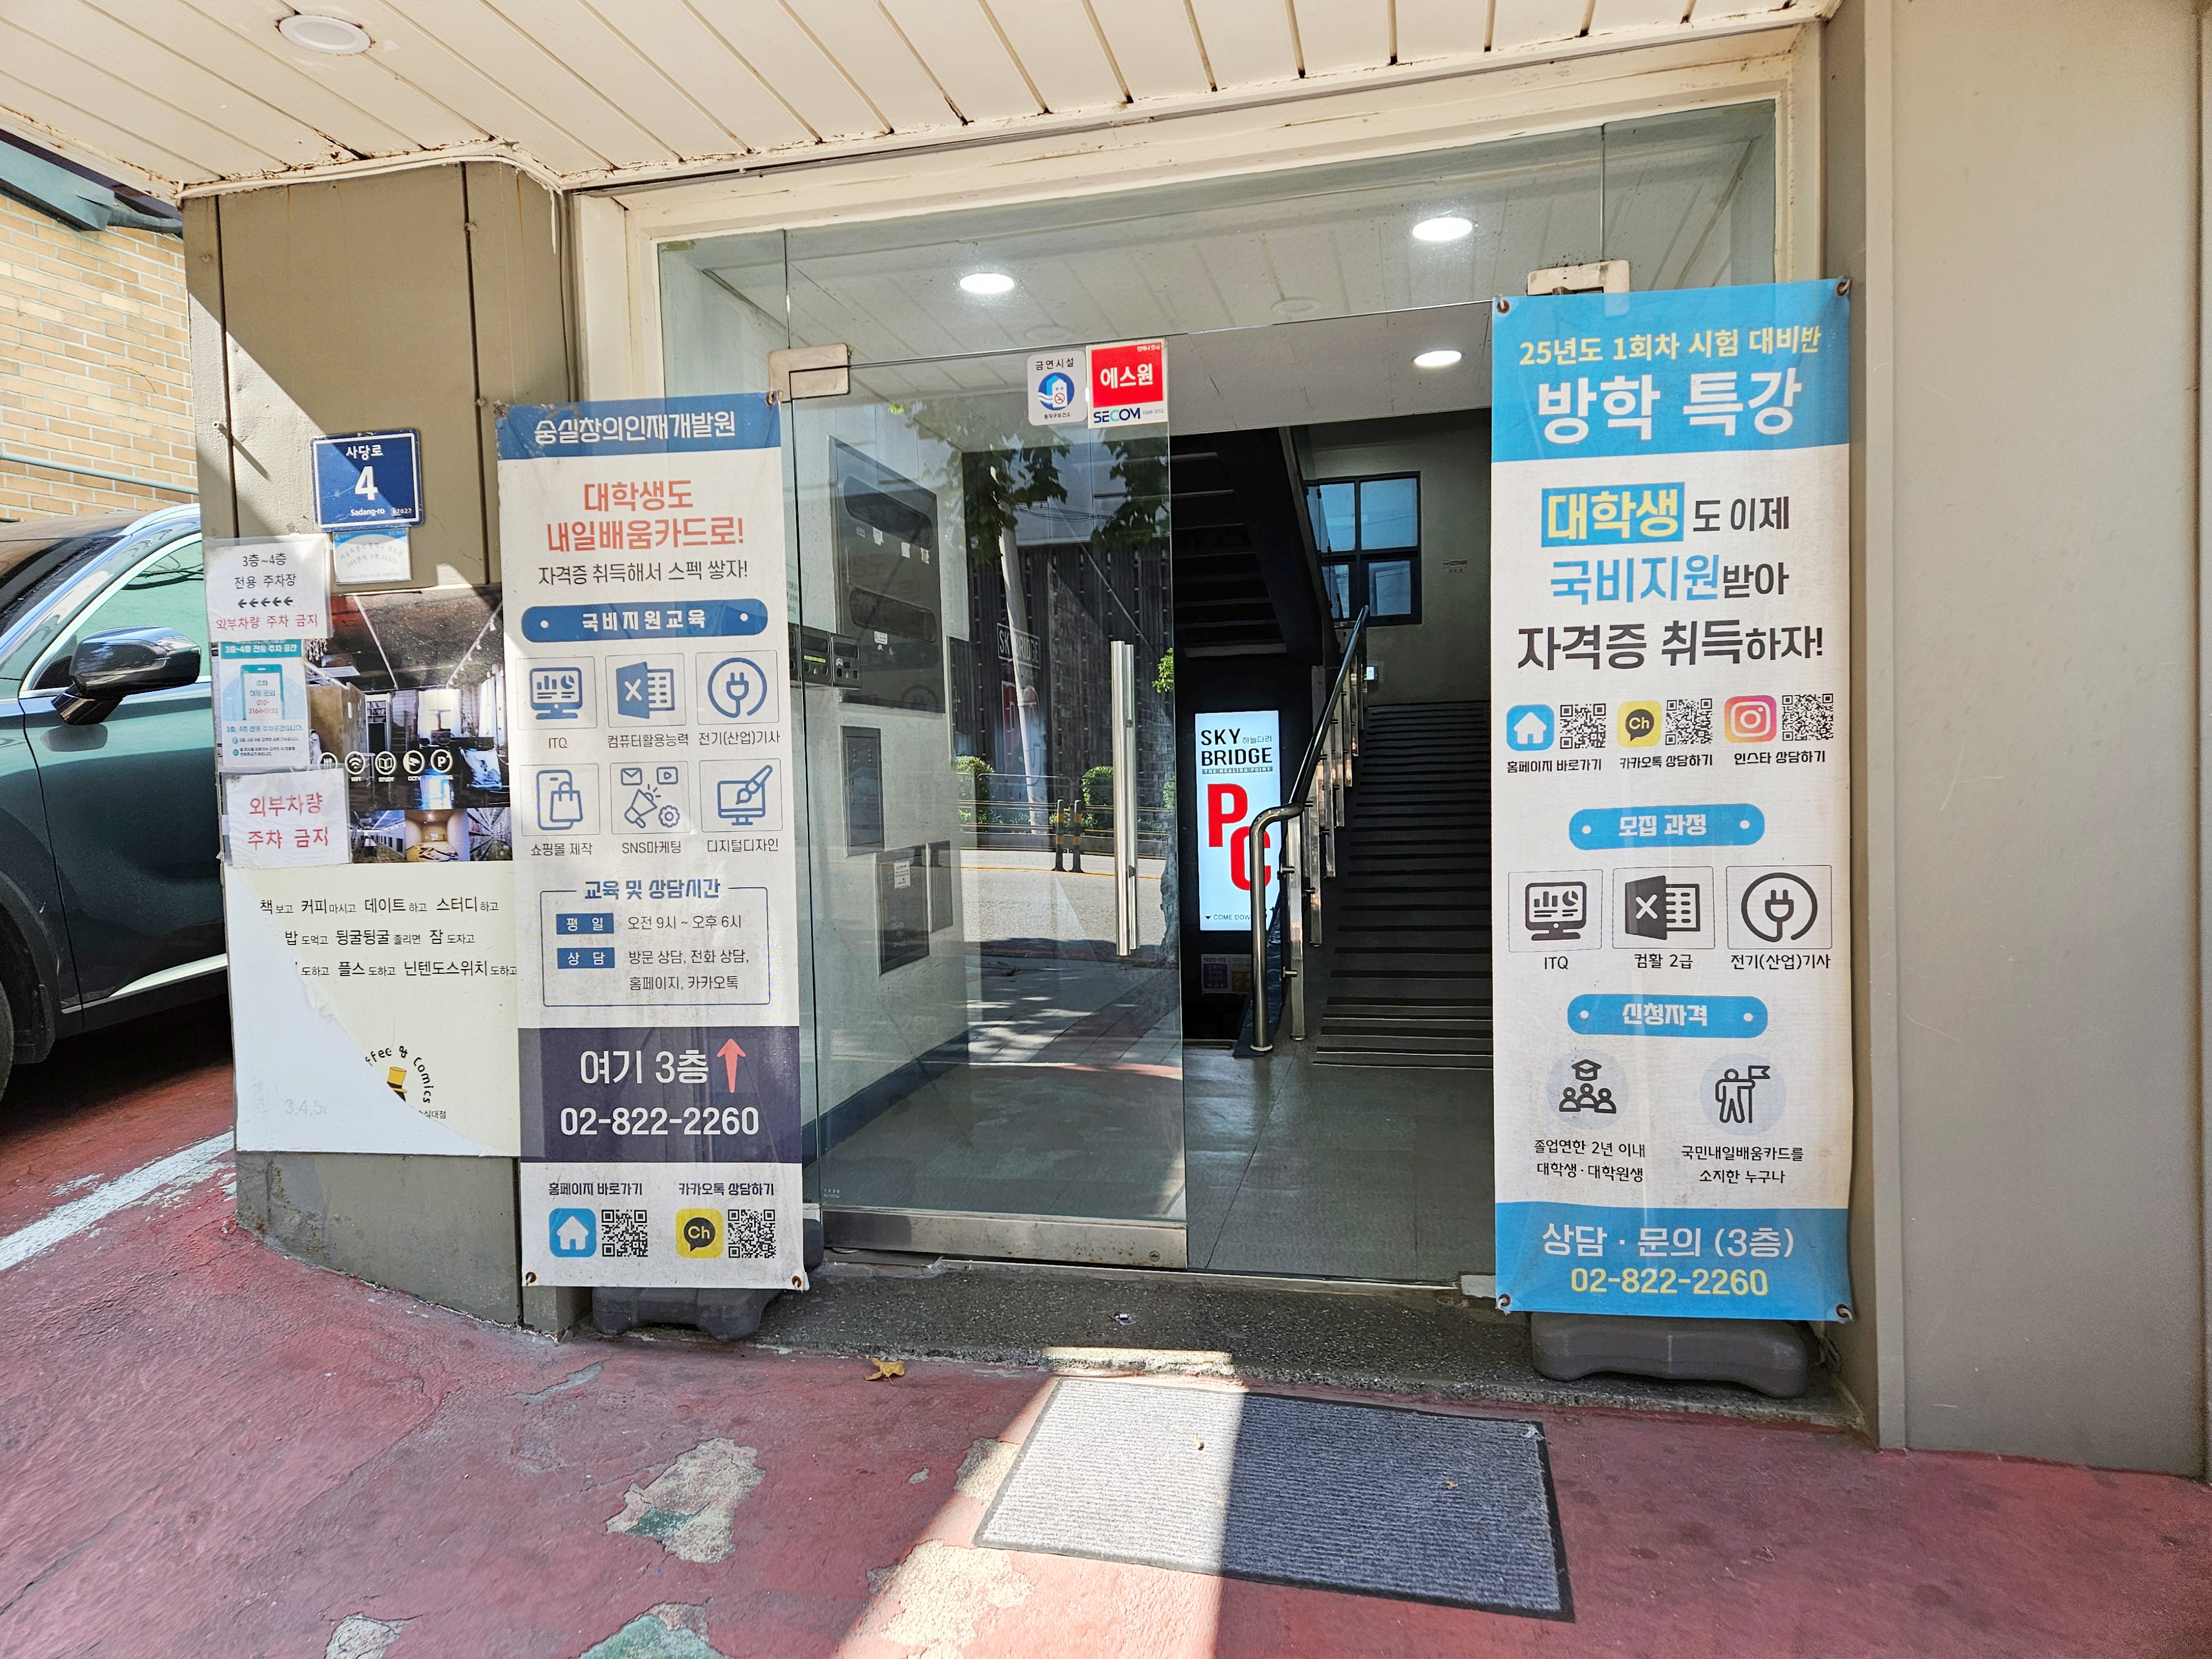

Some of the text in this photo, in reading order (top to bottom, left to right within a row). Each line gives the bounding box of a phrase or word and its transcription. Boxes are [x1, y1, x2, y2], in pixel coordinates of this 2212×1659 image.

[1519, 325, 1820, 366] 25년도 1회차 시험 대비반
[1035, 357, 1074, 371] 금연시설
[1100, 363, 1153, 389] 에스원
[1538, 367, 1802, 445] 방학 특강
[1093, 408, 1140, 424] SECOM
[535, 411, 735, 445] 숭실창의인재개발원
[346, 444, 384, 461] 사당로
[355, 466, 378, 500] 4
[585, 480, 693, 512] 대학생도
[351, 508, 385, 517] Sadang-ro
[1548, 488, 1679, 540] 대학생
[1730, 495, 1790, 530] 이제
[547, 517, 743, 552] 내일배움카드로!
[243, 552, 286, 567] 3층~4층
[234, 573, 296, 589] 전용 주차장
[538, 560, 748, 586] 자격증 취득해서 스펙 쌓자!
[216, 613, 318, 631] 외부차량 주차 금지
[582, 609, 706, 632] 국비지원교육
[1517, 619, 1823, 670] 자격증 취득하자!
[548, 737, 568, 749] ITQ
[607, 733, 689, 748] 컴퓨터활용능력
[698, 731, 781, 746] 전기(산업)기사
[1201, 728, 1240, 745] SKY
[1201, 747, 1272, 766] BRIDGE
[1620, 754, 1713, 769] 카카오톡 상담하기
[1734, 750, 1826, 765] 인스타 상담하기
[1506, 758, 1602, 773] 홈페이지 바로가기
[249, 792, 323, 817] 외부차량
[1619, 813, 1707, 837] 모집 과정
[248, 827, 328, 851] 주차 금지
[622, 839, 682, 854] SNS마케팅
[707, 838, 779, 853] 디지털디자인
[531, 842, 593, 857] 쇼핑몰 제작
[585, 878, 721, 900] 교육 및 상담시간
[627, 916, 652, 930] 오전
[656, 916, 677, 930] 9시
[692, 915, 718, 930] 오후
[721, 914, 742, 929] 6시
[336, 930, 390, 946] 뒹굴뒹굴
[393, 933, 421, 945] 졸리면
[628, 950, 654, 965] 방문
[658, 950, 686, 965] 상담,
[690, 950, 716, 964] 전화
[720, 948, 749, 964] 상담,
[1544, 956, 1569, 971] ITQ
[1634, 953, 1693, 969] 컴활 2급
[1731, 953, 1831, 971] 전기(산업)기사
[338, 962, 366, 977] 플스
[404, 961, 488, 976] 닌텐도스위치
[629, 975, 739, 992] 홈페이지, 카카오톡
[1623, 1003, 1708, 1027] 신청자격
[365, 1045, 434, 1103] ffee & Comics
[580, 1048, 709, 1084] 여기 3층
[419, 1110, 446, 1119] 실대점
[560, 1107, 760, 1136] 02-822-2260
[1534, 1139, 1646, 1158] 졸업연한 2년 이내
[1681, 1145, 1804, 1162] 국민내일배움카드를
[1699, 1170, 1786, 1185] 소지한 누구나
[548, 1182, 643, 1197] 홈페이지 바로가기
[679, 1182, 774, 1196] 카카오톡 상담하기
[1542, 1223, 1608, 1258] 상담
[1638, 1228, 1700, 1258] 문의
[1715, 1227, 1795, 1258] (3층)
[1571, 1268, 1768, 1296] 02-822-2260
